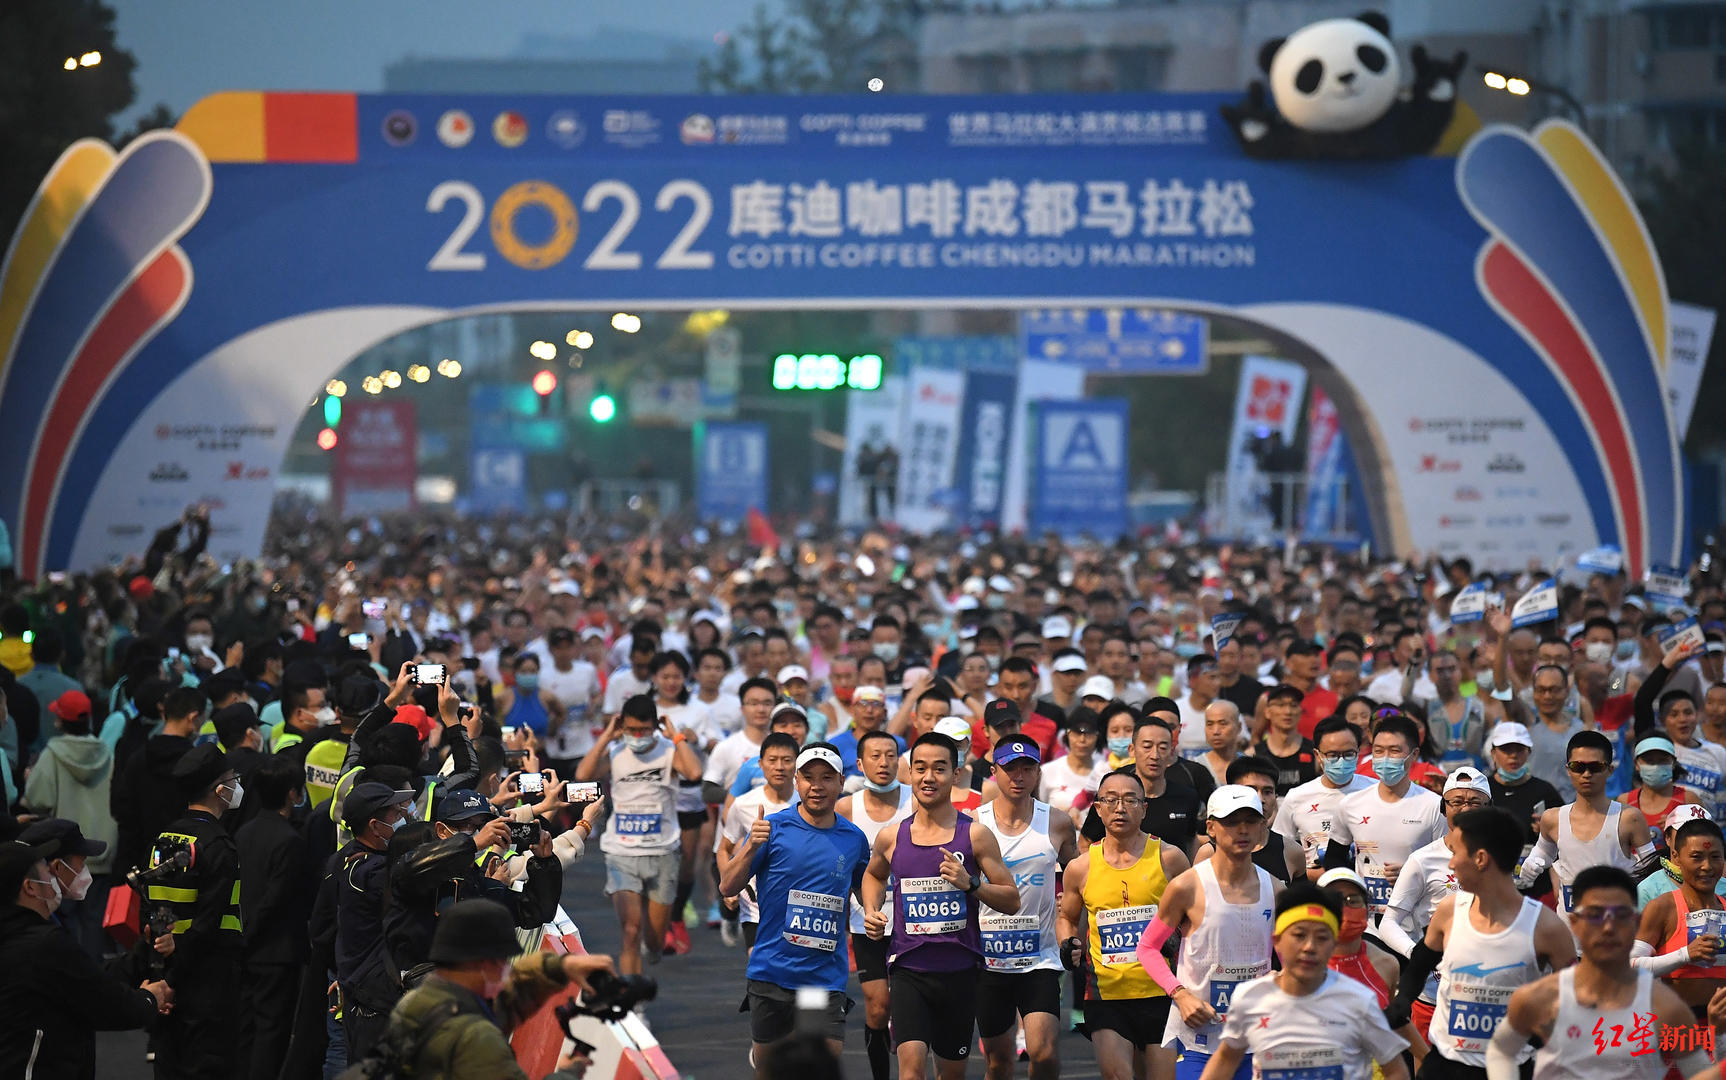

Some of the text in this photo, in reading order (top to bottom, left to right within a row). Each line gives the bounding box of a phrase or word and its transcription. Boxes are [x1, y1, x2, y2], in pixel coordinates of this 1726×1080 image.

[426, 179, 1254, 271] 2022 库迪咖啡成都马拉松
[727, 244, 1255, 268] COTTI COFFEE CHENGDU MARATHON
[1063, 419, 1109, 466] A
[1687, 772, 1717, 789] 0945
[801, 893, 821, 901] COTTI
[908, 901, 961, 918] A0969
[1106, 907, 1153, 918] COTTI COFFEE
[790, 915, 838, 935] A1604
[984, 939, 1034, 953] A0146
[1105, 931, 1142, 949] A021
[1463, 986, 1487, 995] COTTI
[1453, 1013, 1505, 1033] A00
